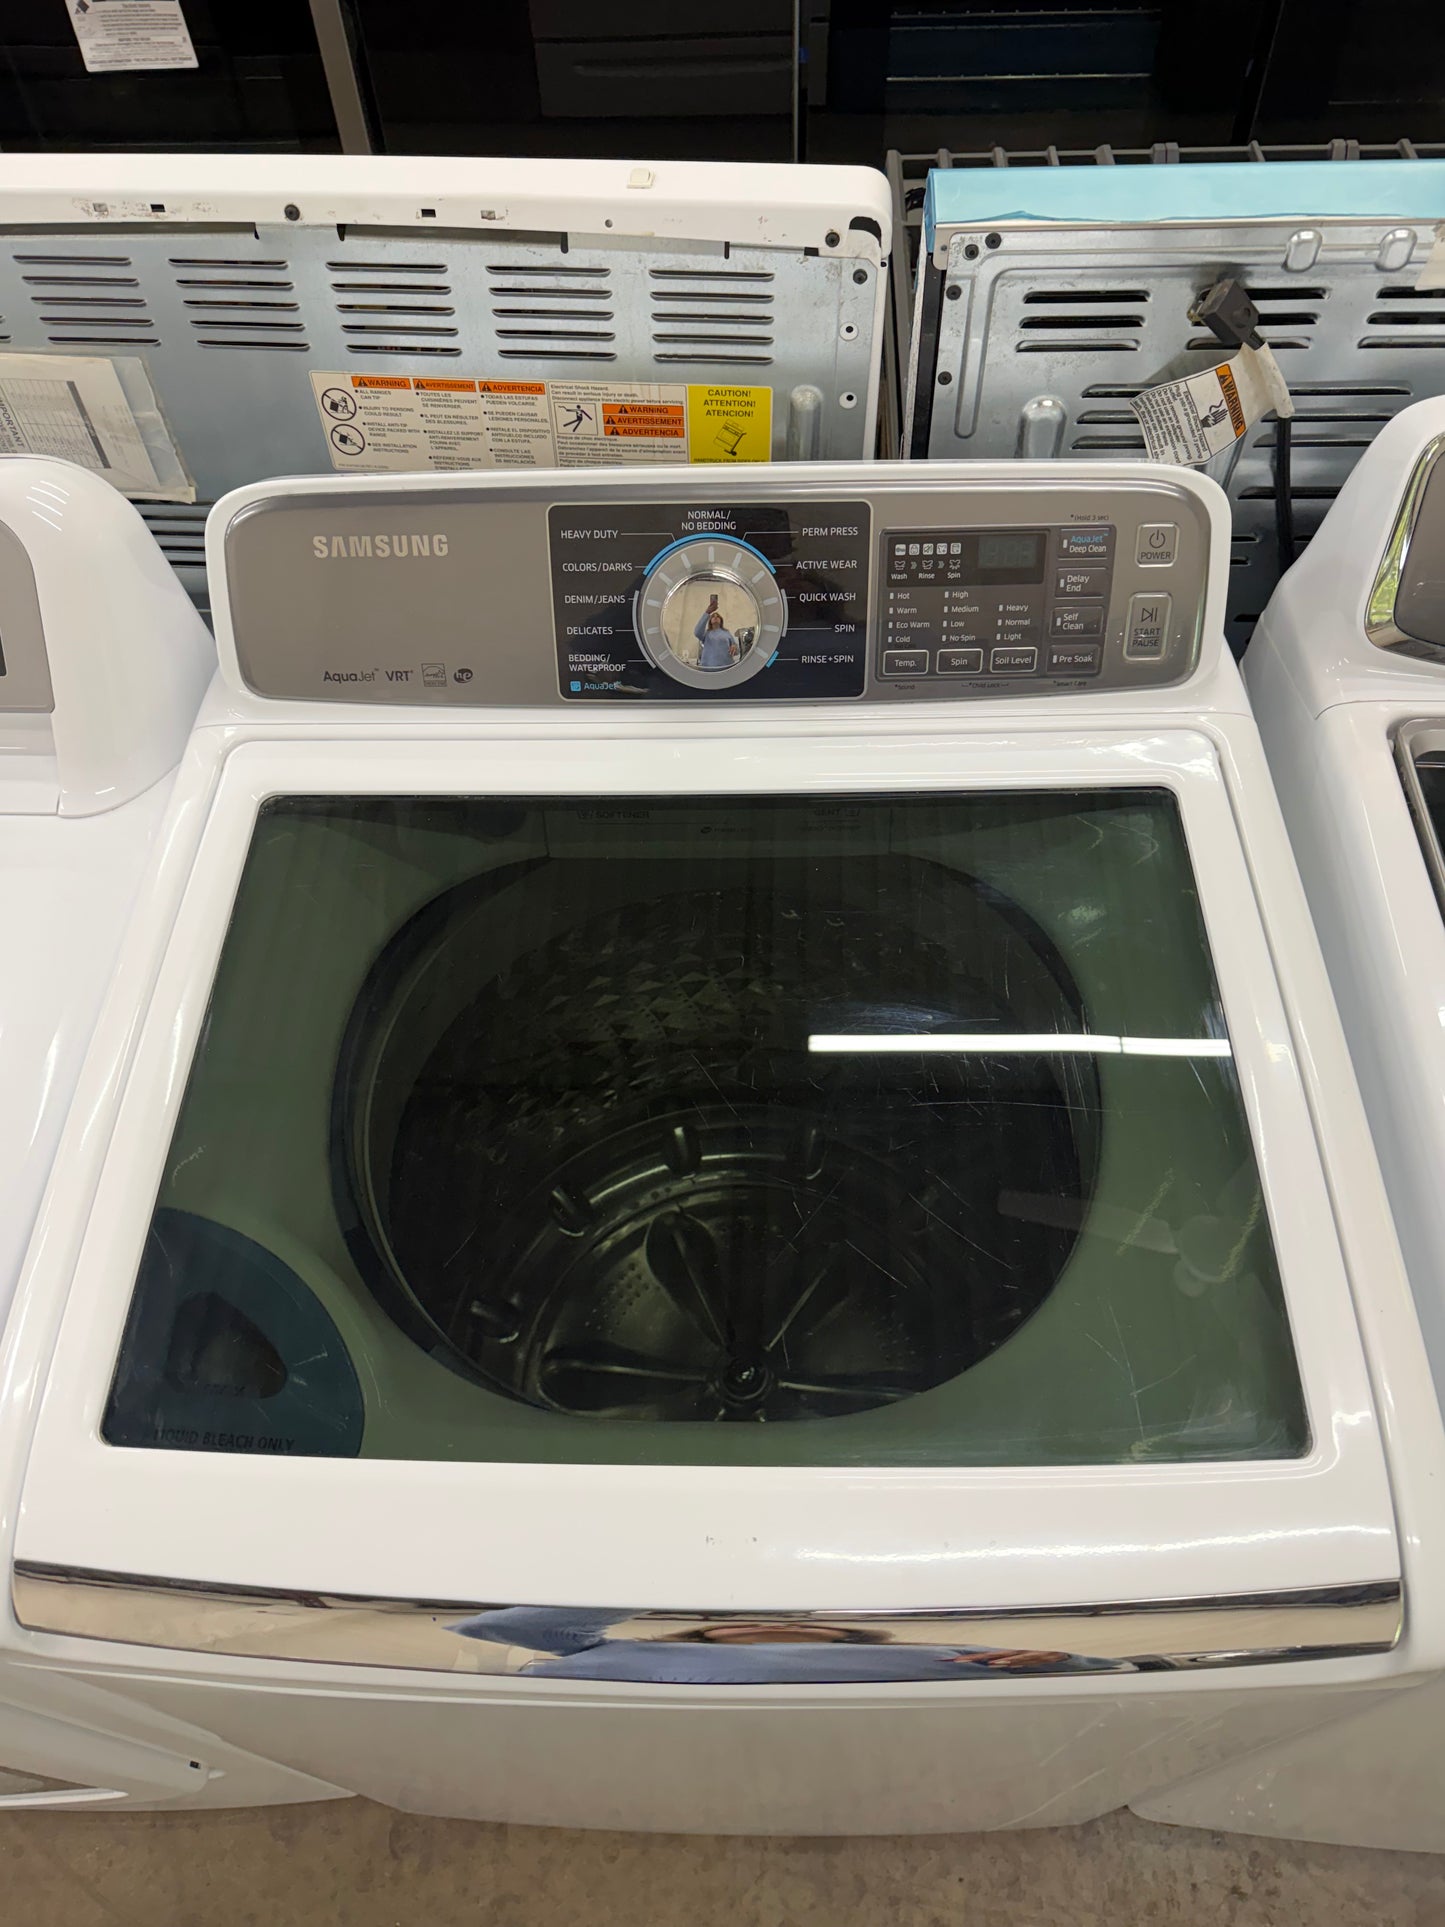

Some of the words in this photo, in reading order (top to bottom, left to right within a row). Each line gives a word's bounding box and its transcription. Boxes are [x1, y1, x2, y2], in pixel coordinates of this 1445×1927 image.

[708, 389, 751, 397] CAUTION!
[703, 399, 756, 407] ATTENTION!
[1223, 382, 1243, 431] WARNING
[629, 406, 668, 414] WARNING
[617, 417, 681, 425] AVERTISSEMENT
[623, 428, 678, 436] ADVERTENCIA
[687, 510, 731, 520] NORMAL/
[681, 522, 694, 531] NO
[696, 521, 736, 531] BEDDING
[561, 530, 592, 539] HEAVY
[593, 529, 618, 539] DUTY
[802, 527, 829, 536] PERM
[831, 526, 858, 536] PRESS
[312, 534, 449, 558] SAMSUNG
[1069, 545, 1087, 554] Deep
[1088, 544, 1107, 552] Clean
[1141, 552, 1171, 560] POWER
[562, 562, 633, 573] COLORS/DARKS
[796, 560, 828, 570] ACTIVE
[830, 560, 857, 569] WEAR
[918, 572, 935, 580] Rinse
[947, 572, 961, 580] Spin
[1067, 575, 1089, 584] Delay
[1066, 584, 1082, 592] End
[564, 594, 625, 605] DENIM/JEANS
[799, 592, 830, 602] QUICK
[831, 592, 856, 602] WASH
[952, 591, 969, 599] High
[1006, 604, 1028, 613] Heavy
[1063, 613, 1079, 621] Self
[896, 621, 909, 629] Eco
[1005, 618, 1030, 626] Normal
[1062, 622, 1084, 630] Clean
[566, 626, 613, 635] DELICATES
[834, 624, 855, 633] SPIN
[1134, 628, 1160, 636] START
[1004, 633, 1021, 641] Light
[568, 654, 610, 663] BEDDING/
[801, 654, 854, 664] RINSE+SPIN
[951, 658, 968, 666] Spin
[1011, 656, 1032, 664] Level
[1059, 655, 1072, 663] Pre
[1074, 655, 1093, 663] Soak
[568, 663, 627, 672] WATERPROOF
[894, 659, 917, 668] Temp.
[203, 1432, 254, 1449] BLEACH
[258, 1435, 295, 1450] ONLY
